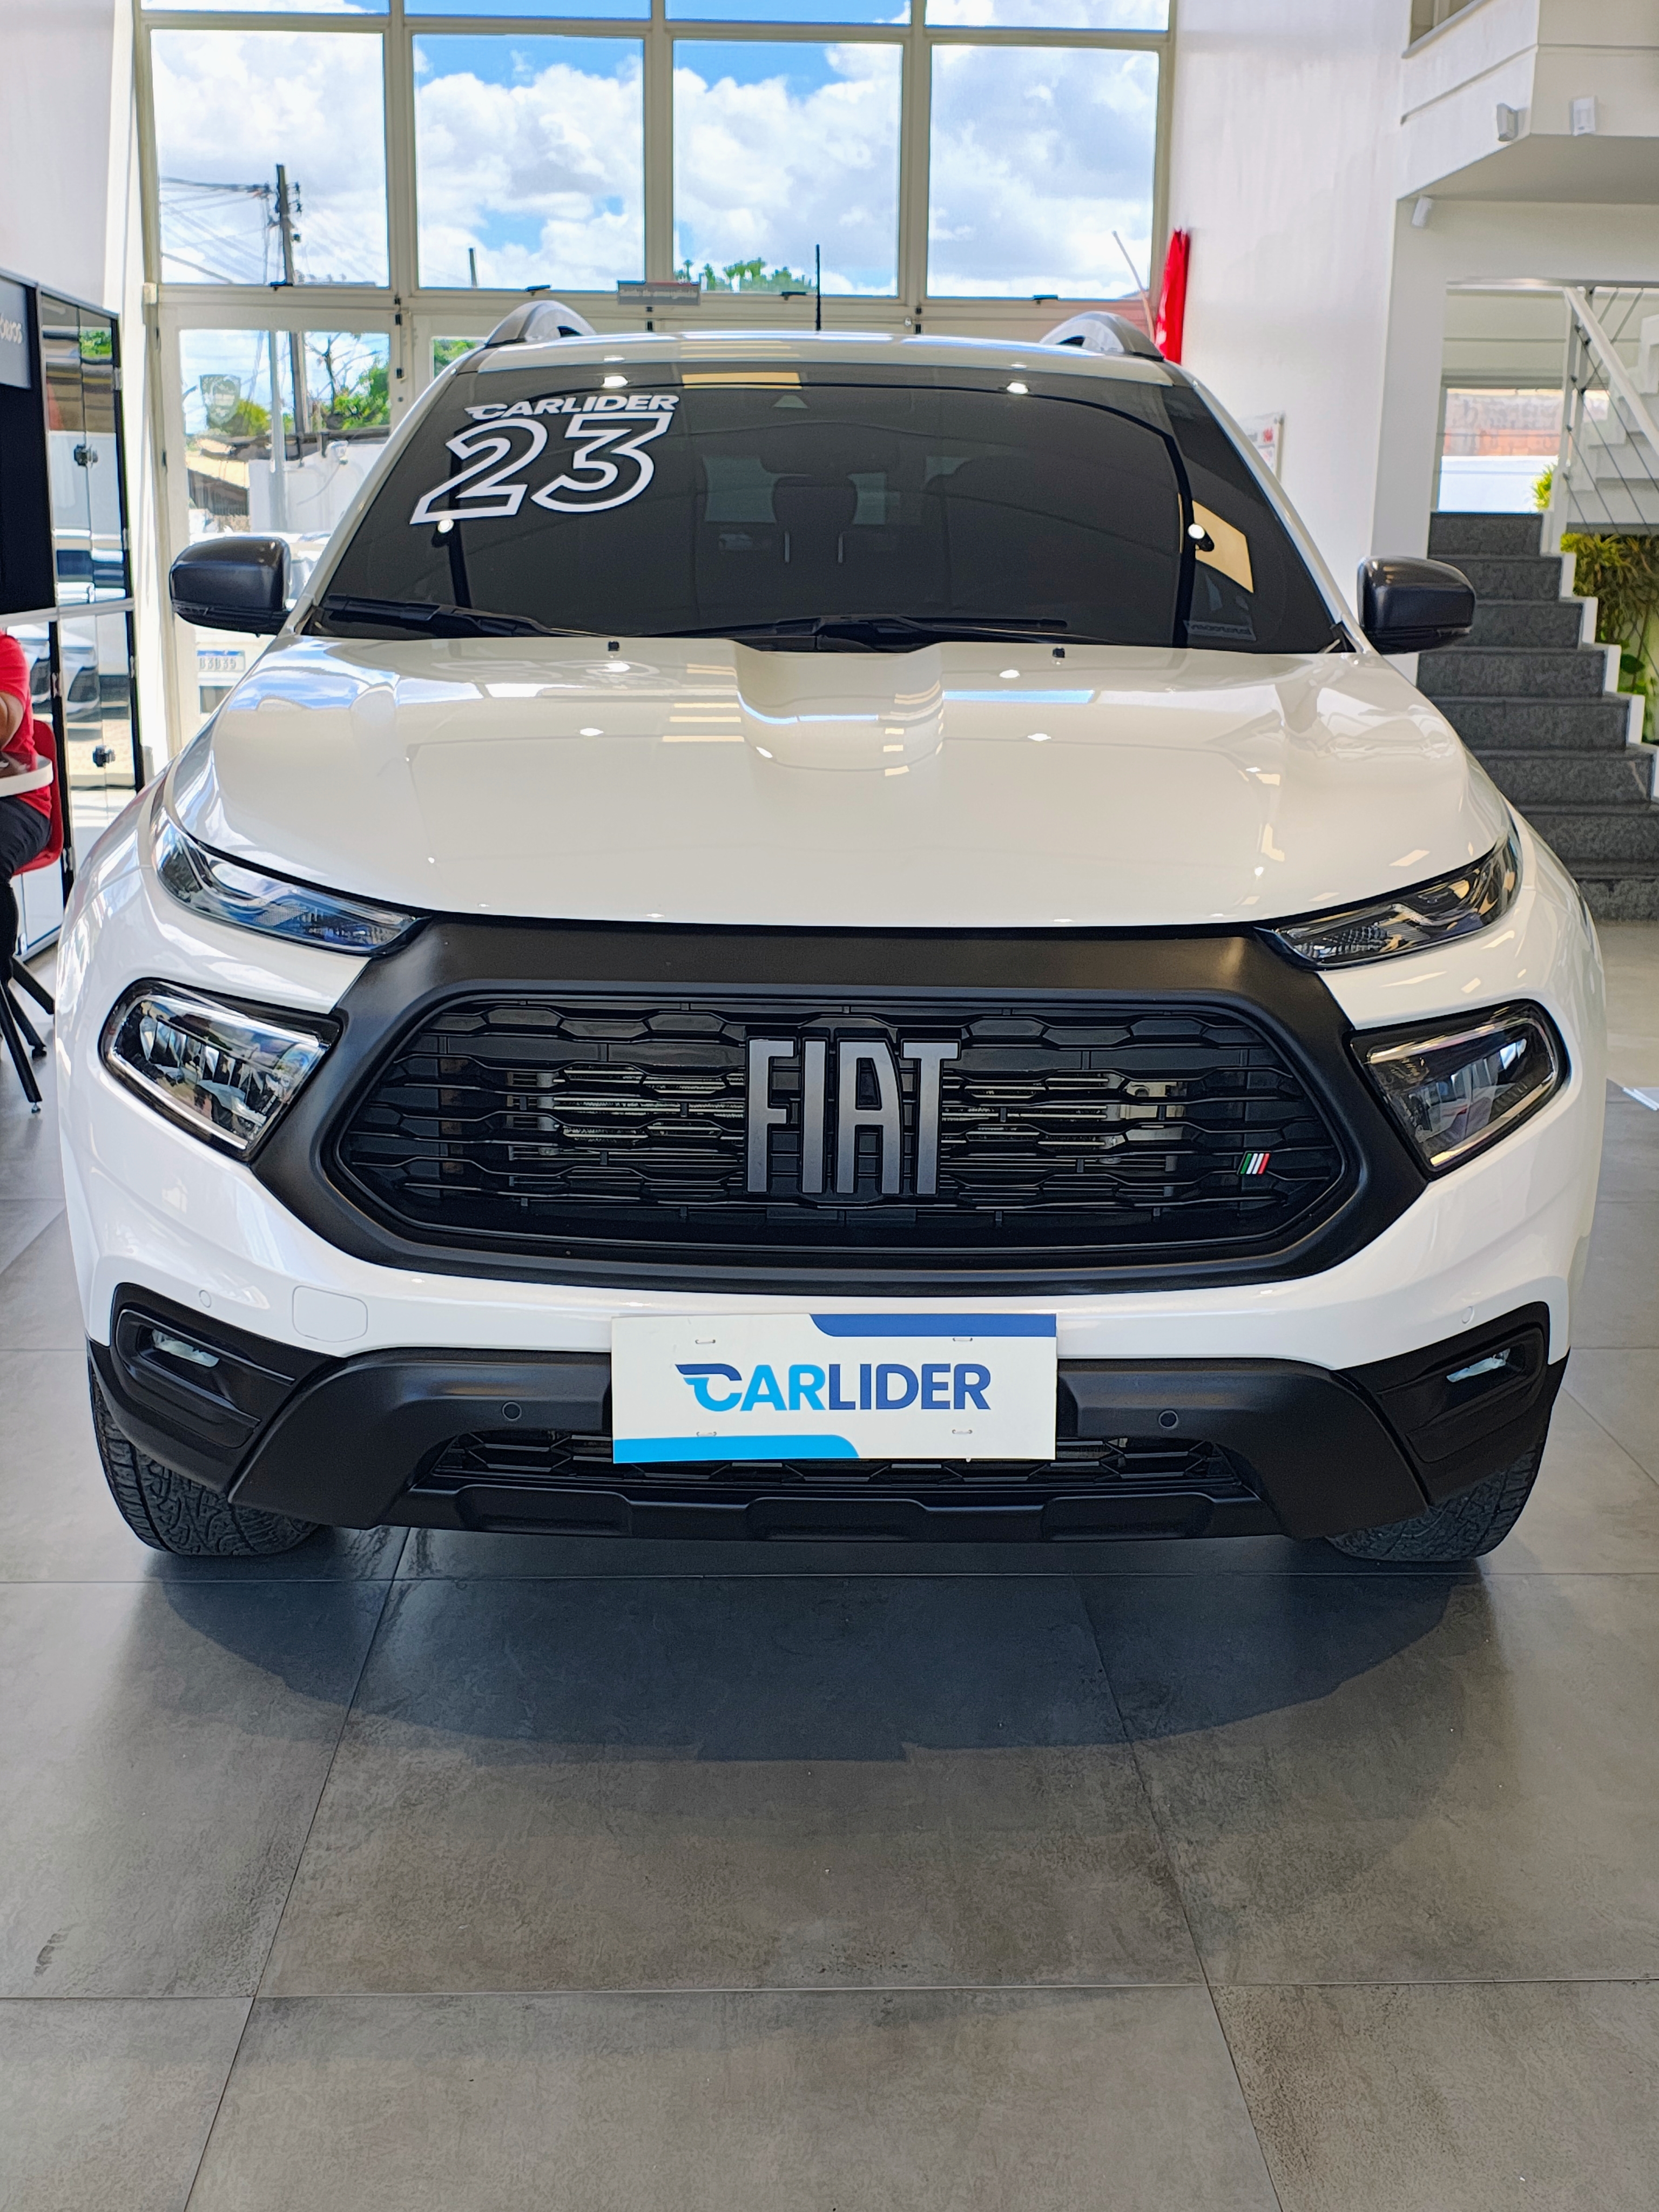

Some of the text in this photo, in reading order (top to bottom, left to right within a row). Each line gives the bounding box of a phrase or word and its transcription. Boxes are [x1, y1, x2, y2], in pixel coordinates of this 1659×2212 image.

[464, 395, 679, 420] CARLIDER
[409, 412, 673, 525] 23
[746, 1039, 960, 1195] FIAT
[675, 1363, 991, 1412] CARLIDER
